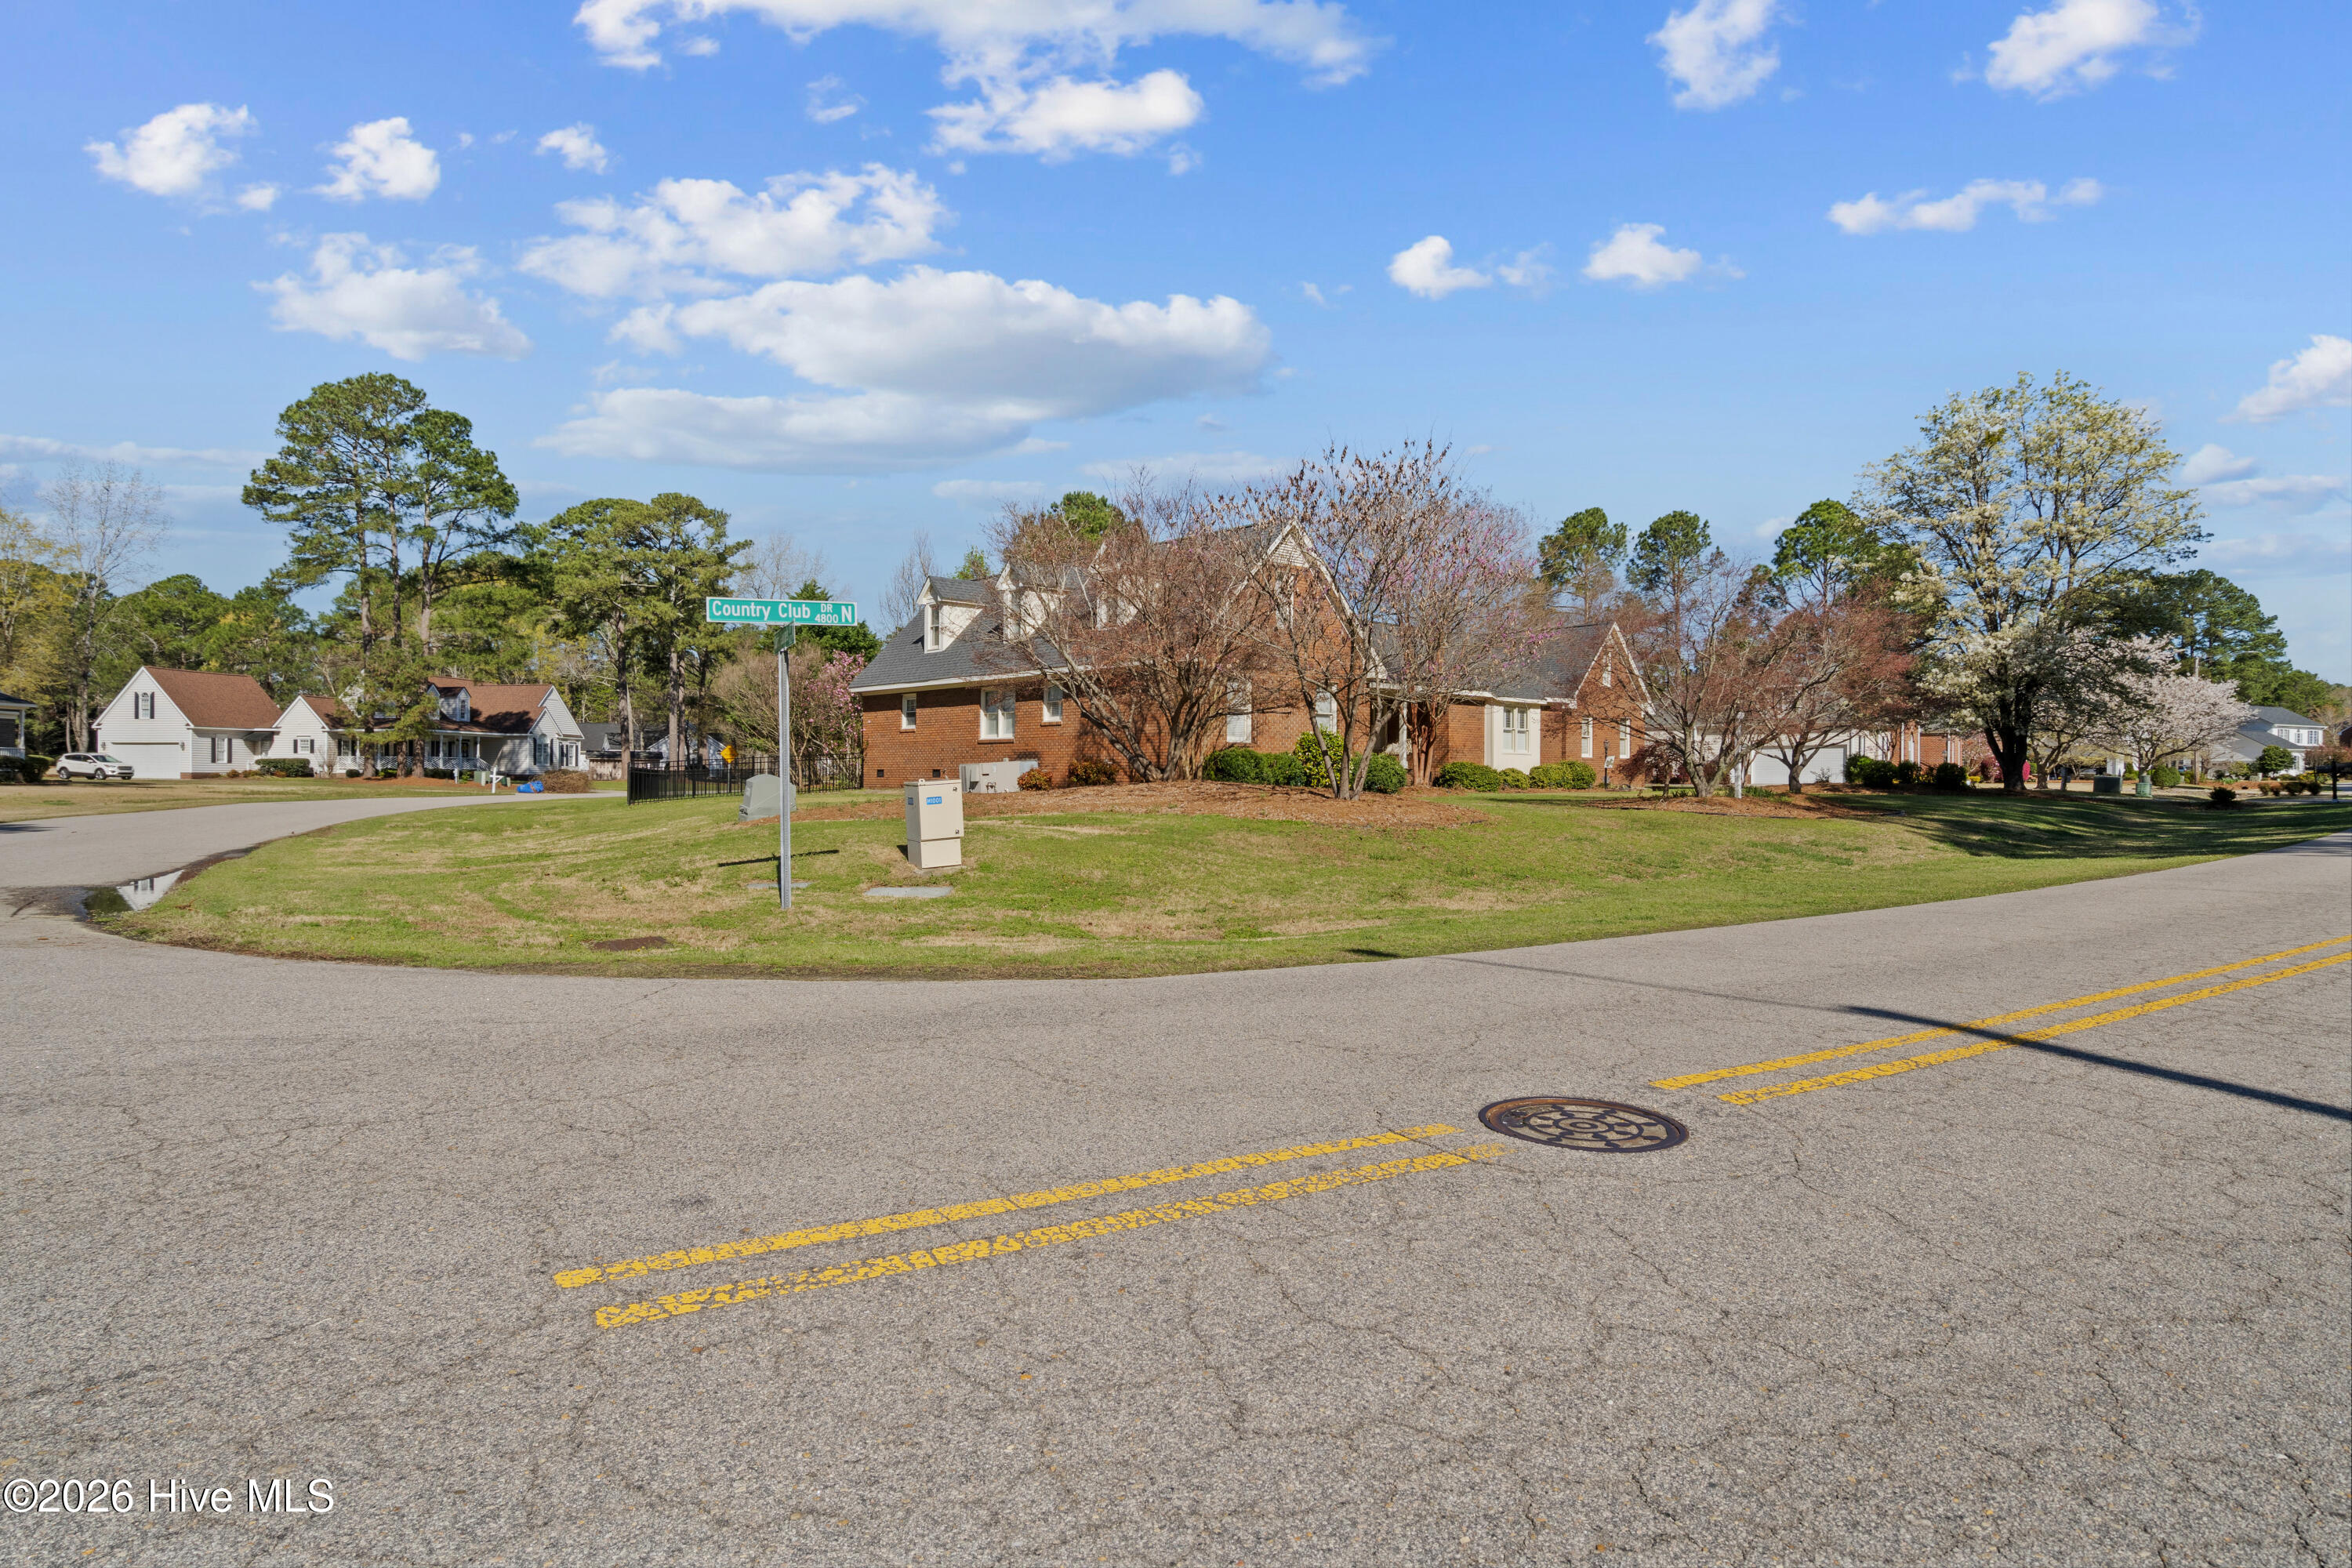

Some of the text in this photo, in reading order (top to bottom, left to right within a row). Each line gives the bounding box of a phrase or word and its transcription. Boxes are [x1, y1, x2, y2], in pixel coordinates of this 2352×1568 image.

[712, 600, 811, 620] Country Club
[820, 603, 833, 613] DR
[840, 605, 852, 622] N
[814, 613, 839, 623] 4800
